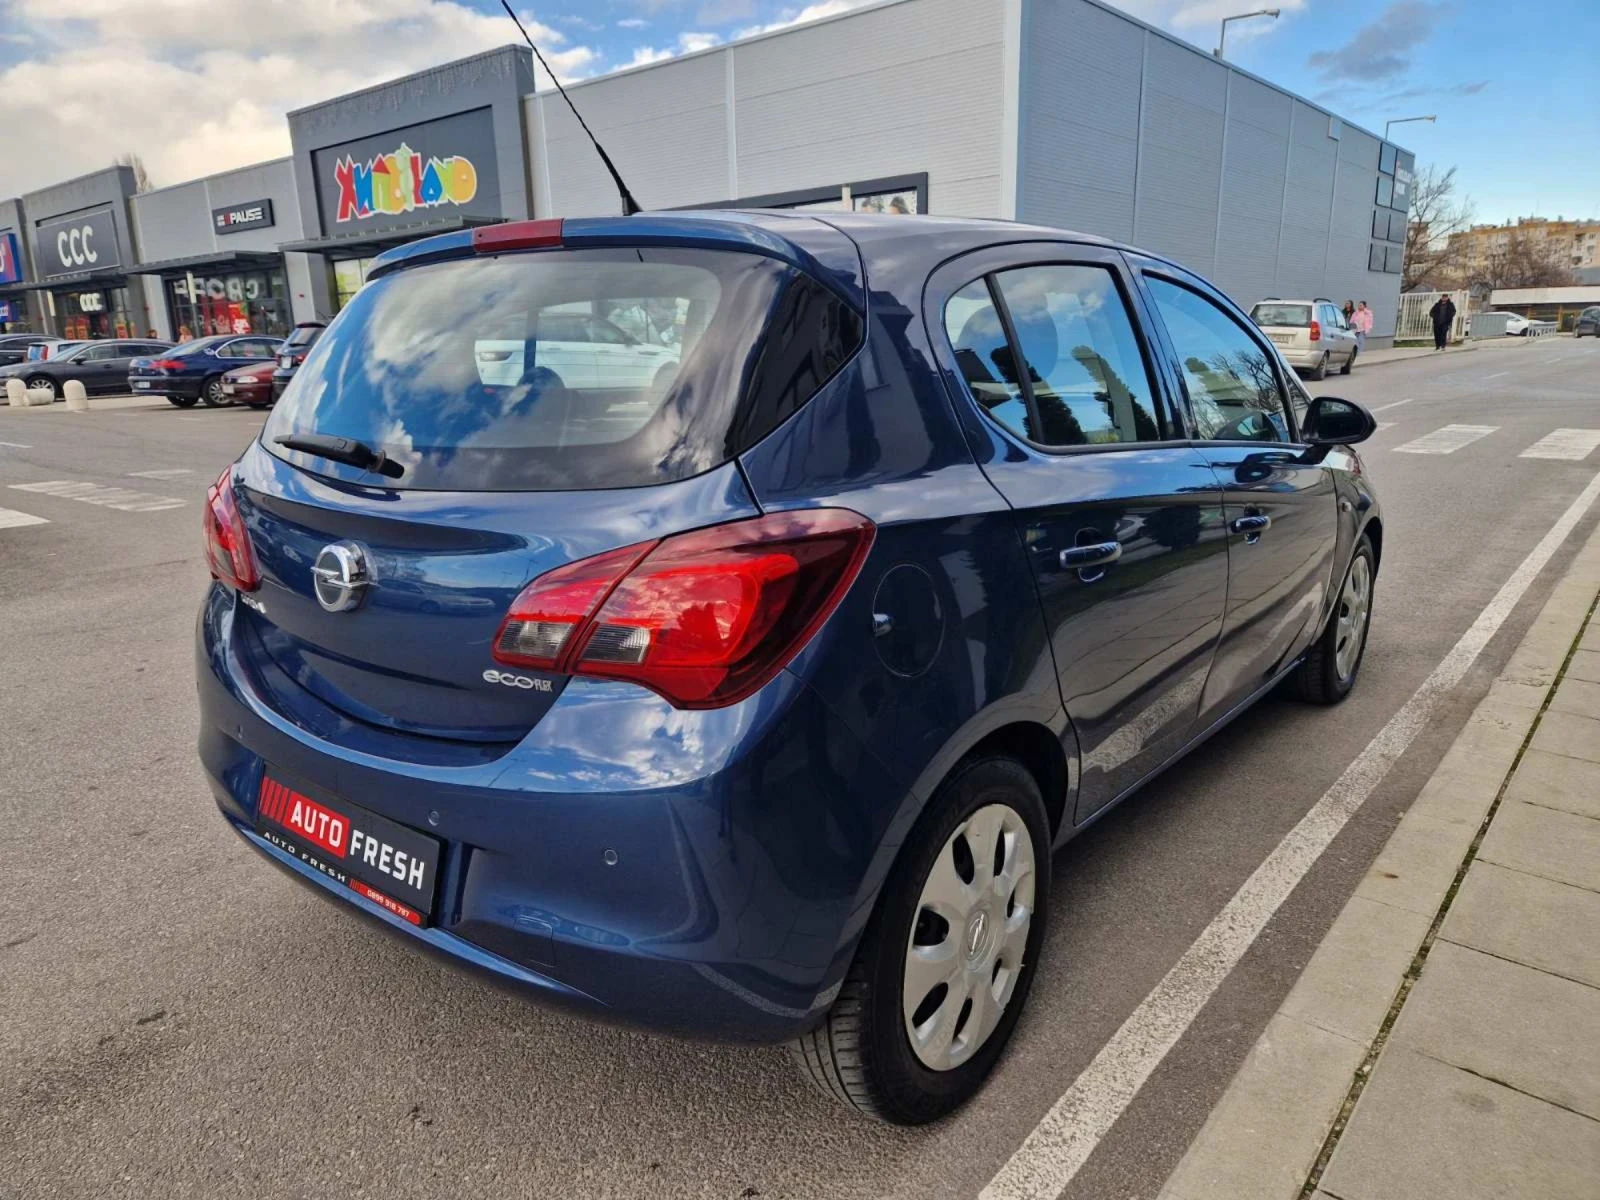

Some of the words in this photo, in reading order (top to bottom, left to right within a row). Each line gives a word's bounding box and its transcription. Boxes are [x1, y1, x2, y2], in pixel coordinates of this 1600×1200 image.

[230, 207, 263, 225] PAUSE
[57, 225, 98, 268] CCC
[79, 293, 103, 312] CCC
[264, 831, 296, 854] AUTO
[301, 853, 346, 883] FRESH
[290, 801, 343, 848] AUTO
[350, 829, 425, 890] FRESH
